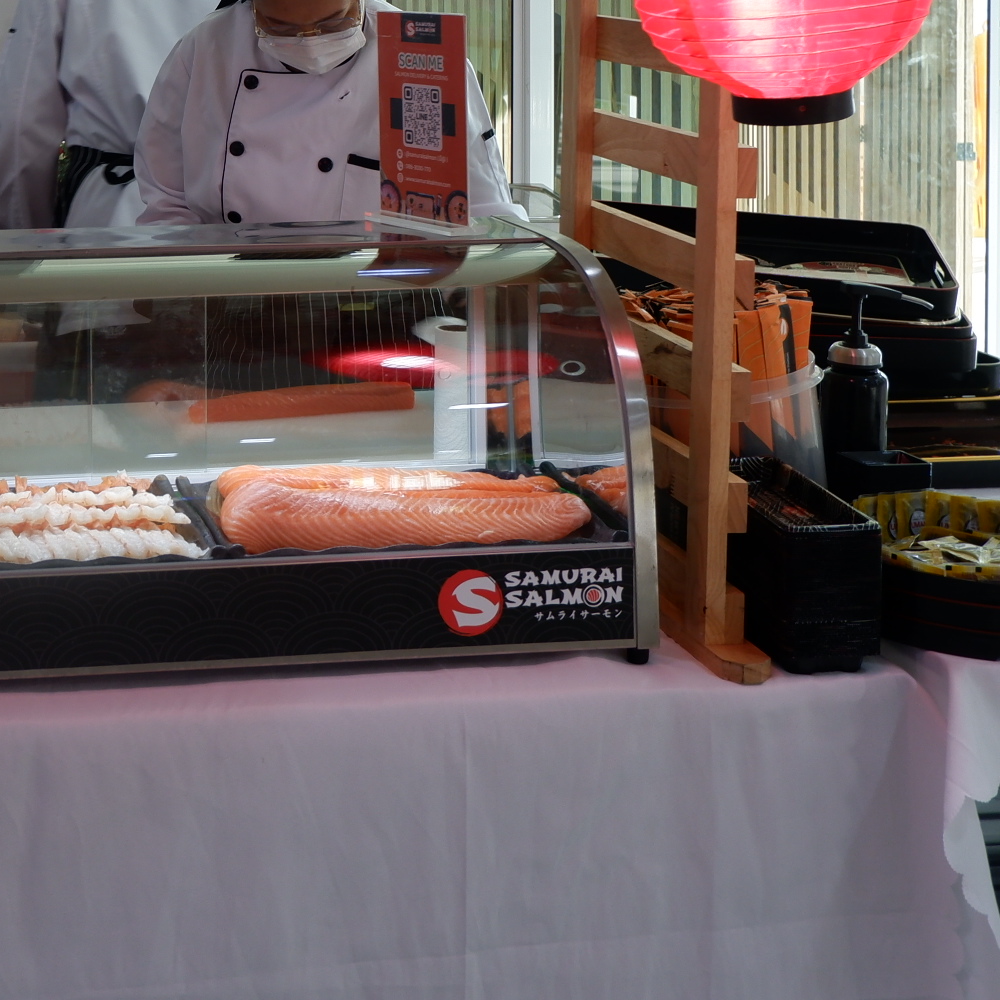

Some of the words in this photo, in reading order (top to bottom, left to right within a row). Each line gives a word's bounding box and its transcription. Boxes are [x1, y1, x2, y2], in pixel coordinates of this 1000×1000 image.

[398, 52, 426, 70] SCAN
[427, 54, 444, 72] ME
[504, 567, 623, 588] SAMURAI
[504, 584, 624, 608] SALMON
[534, 609, 623, 622] サムライサーモン
